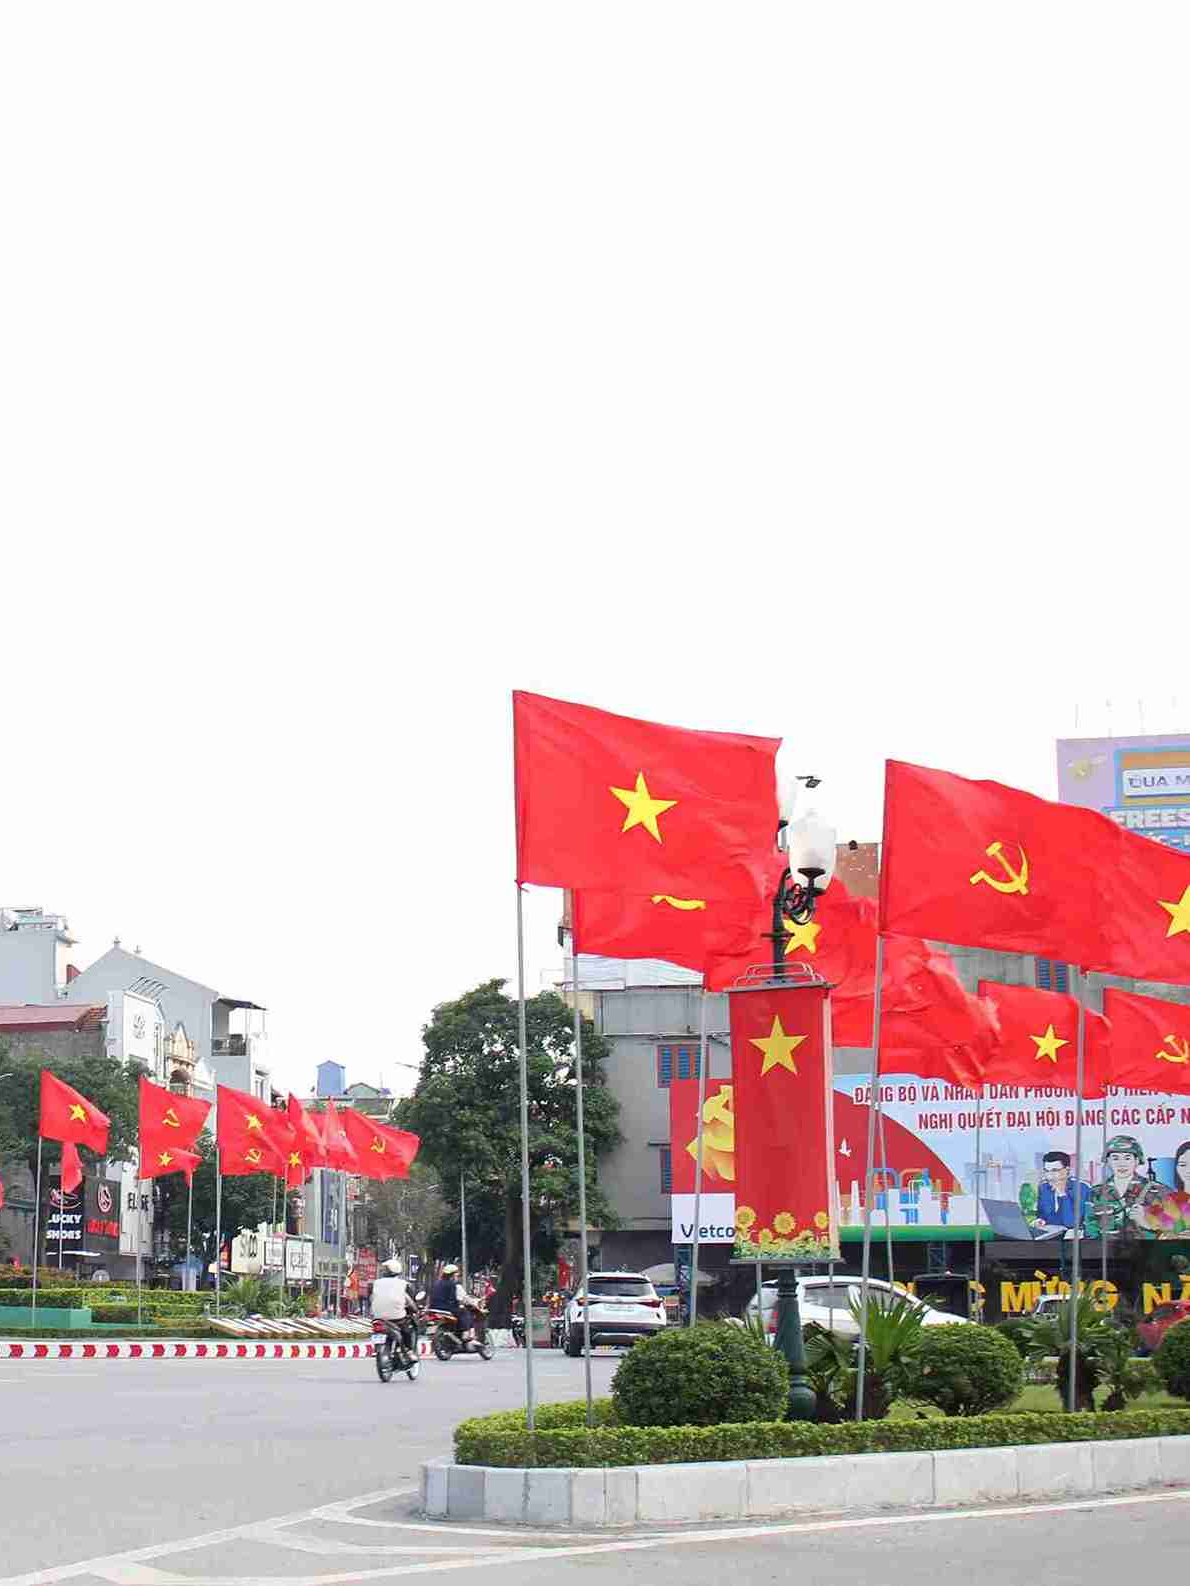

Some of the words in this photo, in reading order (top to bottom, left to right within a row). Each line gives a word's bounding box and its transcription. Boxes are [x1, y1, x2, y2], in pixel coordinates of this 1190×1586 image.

[898, 1083, 917, 1104] BỘ
[921, 1082, 940, 1101] VÀ
[918, 1113, 953, 1133] NGHỊ
[1006, 1111, 1031, 1131] ĐẠI
[1036, 1107, 1060, 1130] HỘI
[1065, 1109, 1106, 1127] ĐNG
[1110, 1105, 1141, 1126] CÁC
[1145, 1103, 1176, 1125] CẤP
[45, 1230, 82, 1240] SHOES
[680, 1223, 736, 1238] Vetco
